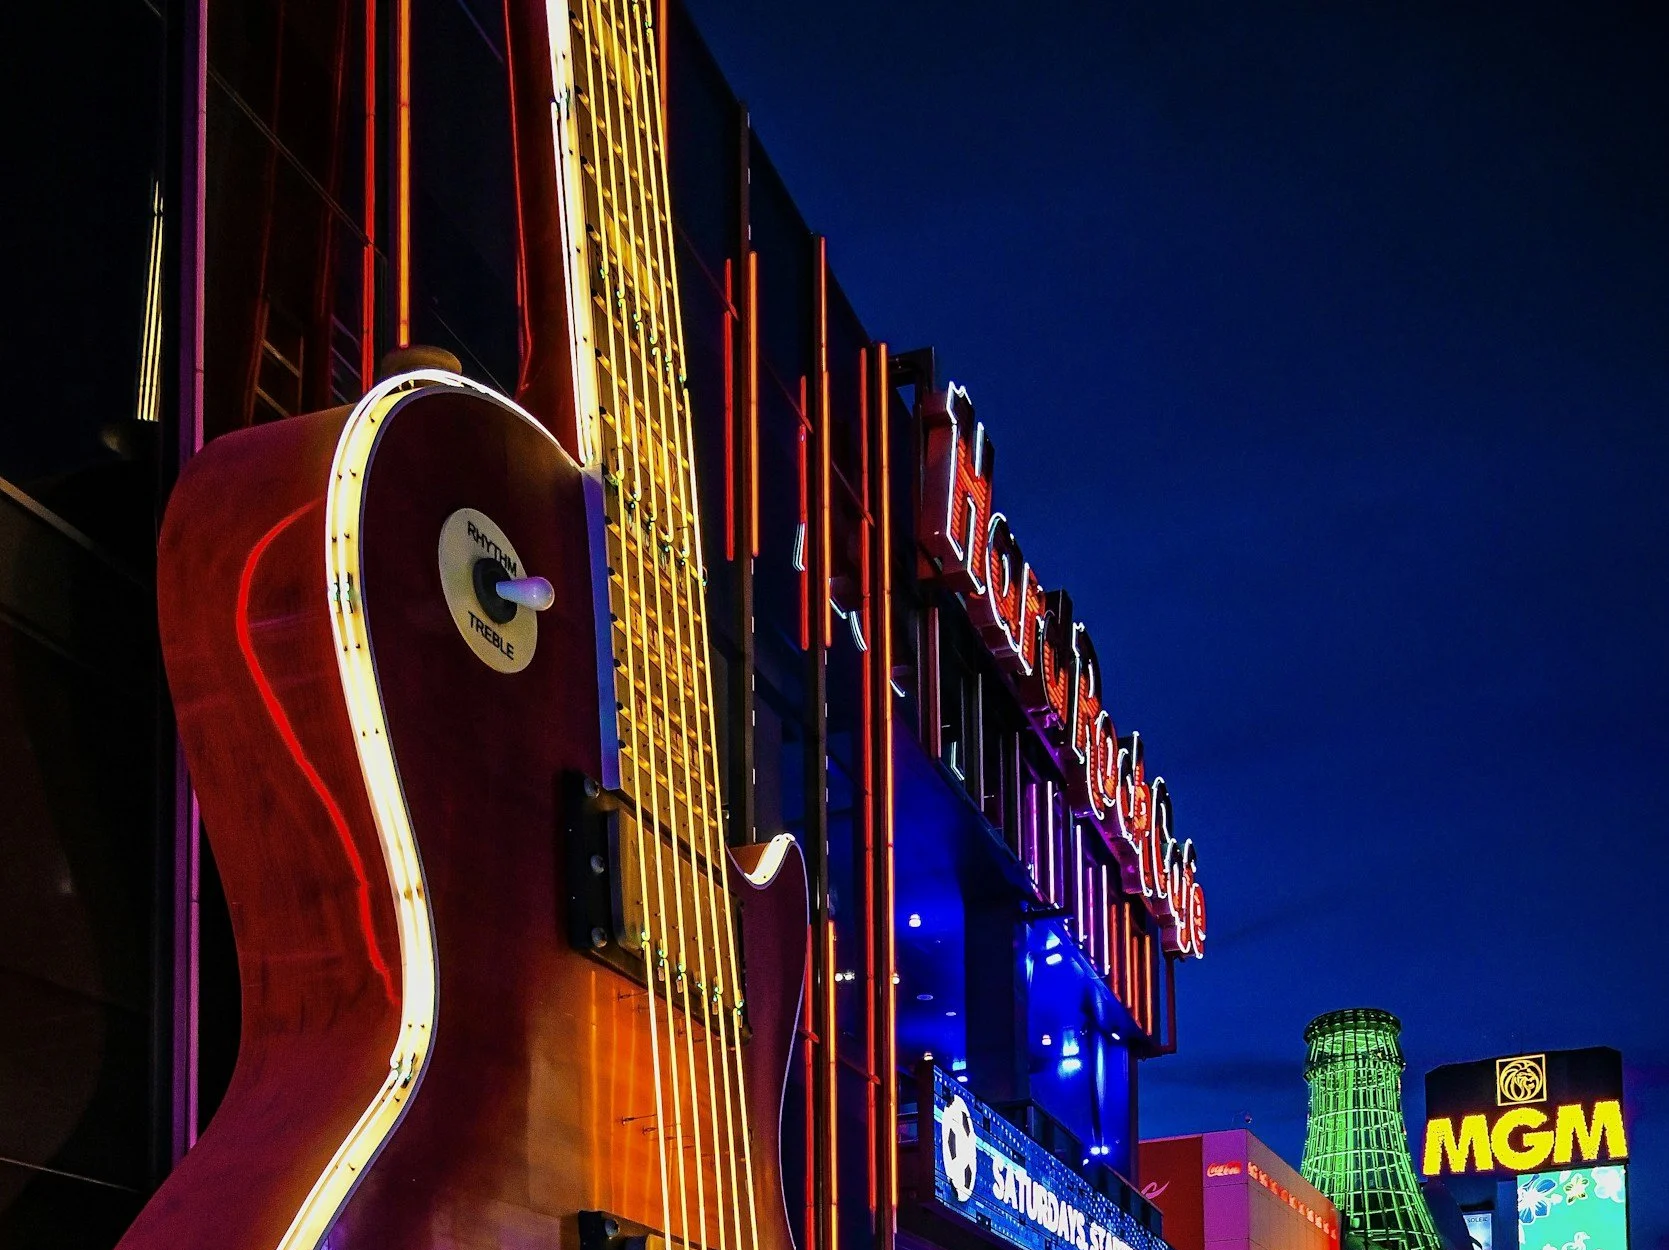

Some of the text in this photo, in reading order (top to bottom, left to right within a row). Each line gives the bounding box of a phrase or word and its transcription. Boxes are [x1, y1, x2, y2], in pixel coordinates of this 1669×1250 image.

[467, 520, 517, 578] RHYTHM
[467, 611, 515, 661] TREBLE
[1423, 1100, 1628, 1176] MGM
